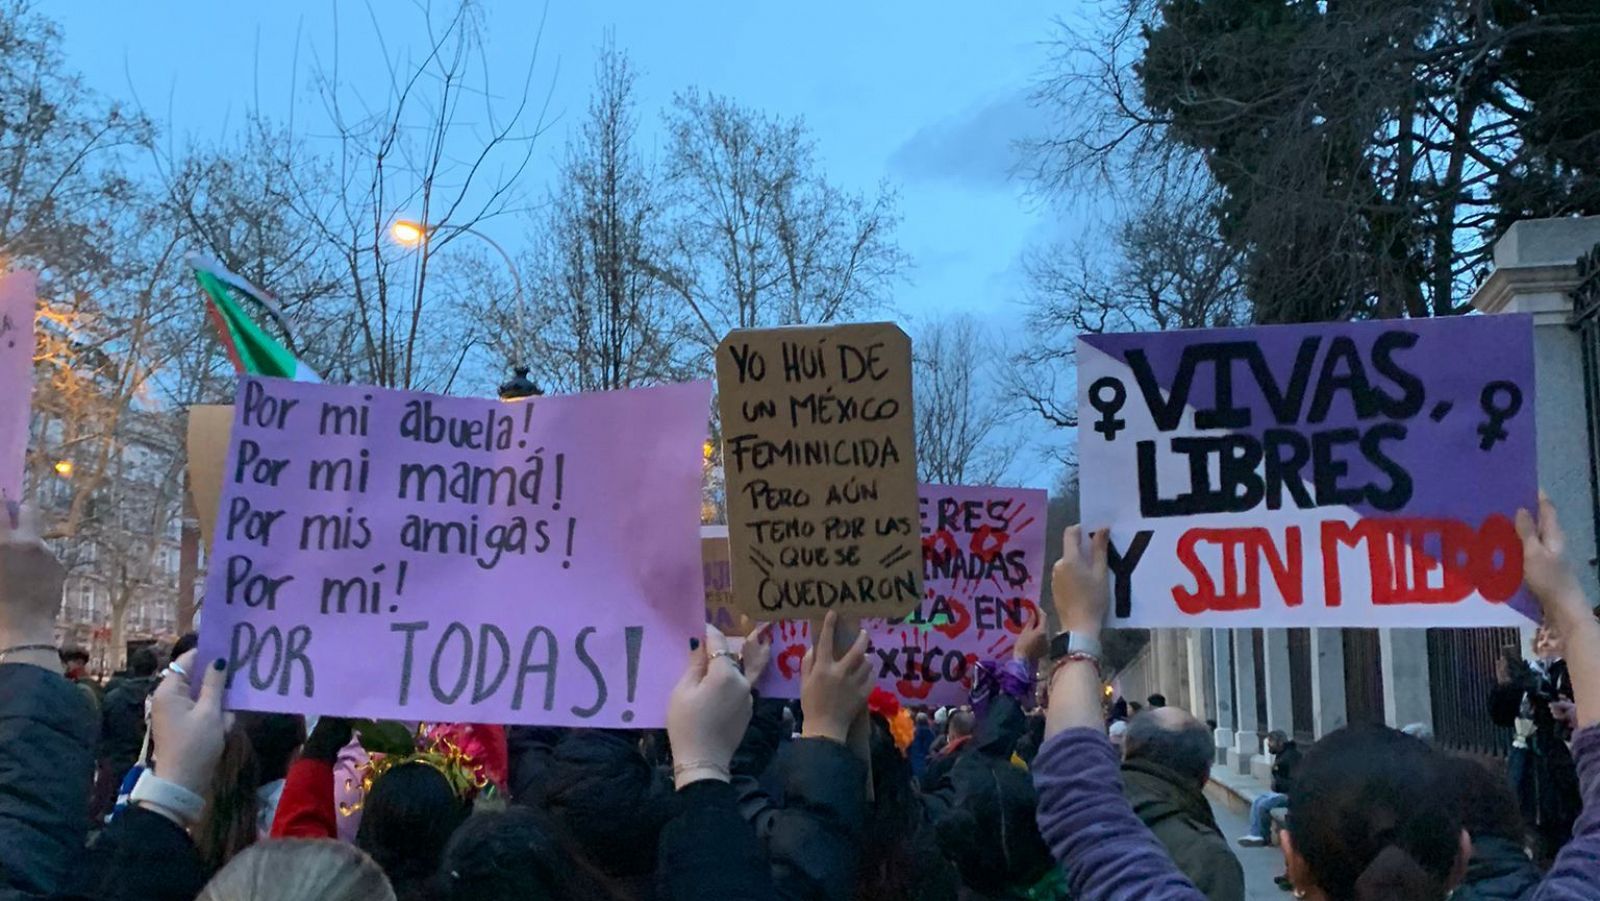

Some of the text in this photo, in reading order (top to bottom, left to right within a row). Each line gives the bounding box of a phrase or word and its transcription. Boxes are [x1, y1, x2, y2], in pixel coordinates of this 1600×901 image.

[729, 339, 889, 388] YO HUÍ DE
[1124, 329, 1454, 431] VIVAS,
[243, 382, 534, 452] Por mi abuela!
[742, 387, 899, 428] UN MÉXICO
[234, 440, 565, 511] Por mi mamá!
[727, 434, 900, 473] FEMINICIDA
[1136, 423, 1414, 518] LIBRES
[742, 476, 878, 511] PERO AÚN
[226, 497, 576, 570] Por mis amigas!
[746, 517, 912, 545] TEMO POR LAS
[779, 546, 861, 568] QUE SE
[1089, 513, 1524, 618] Y SIN MIEDO
[226, 555, 408, 614] Por mí!
[758, 570, 920, 612] QUEDARON
[975, 595, 1022, 629] EN
[225, 620, 644, 723] POR TODAS!
[866, 645, 967, 682] XICO
